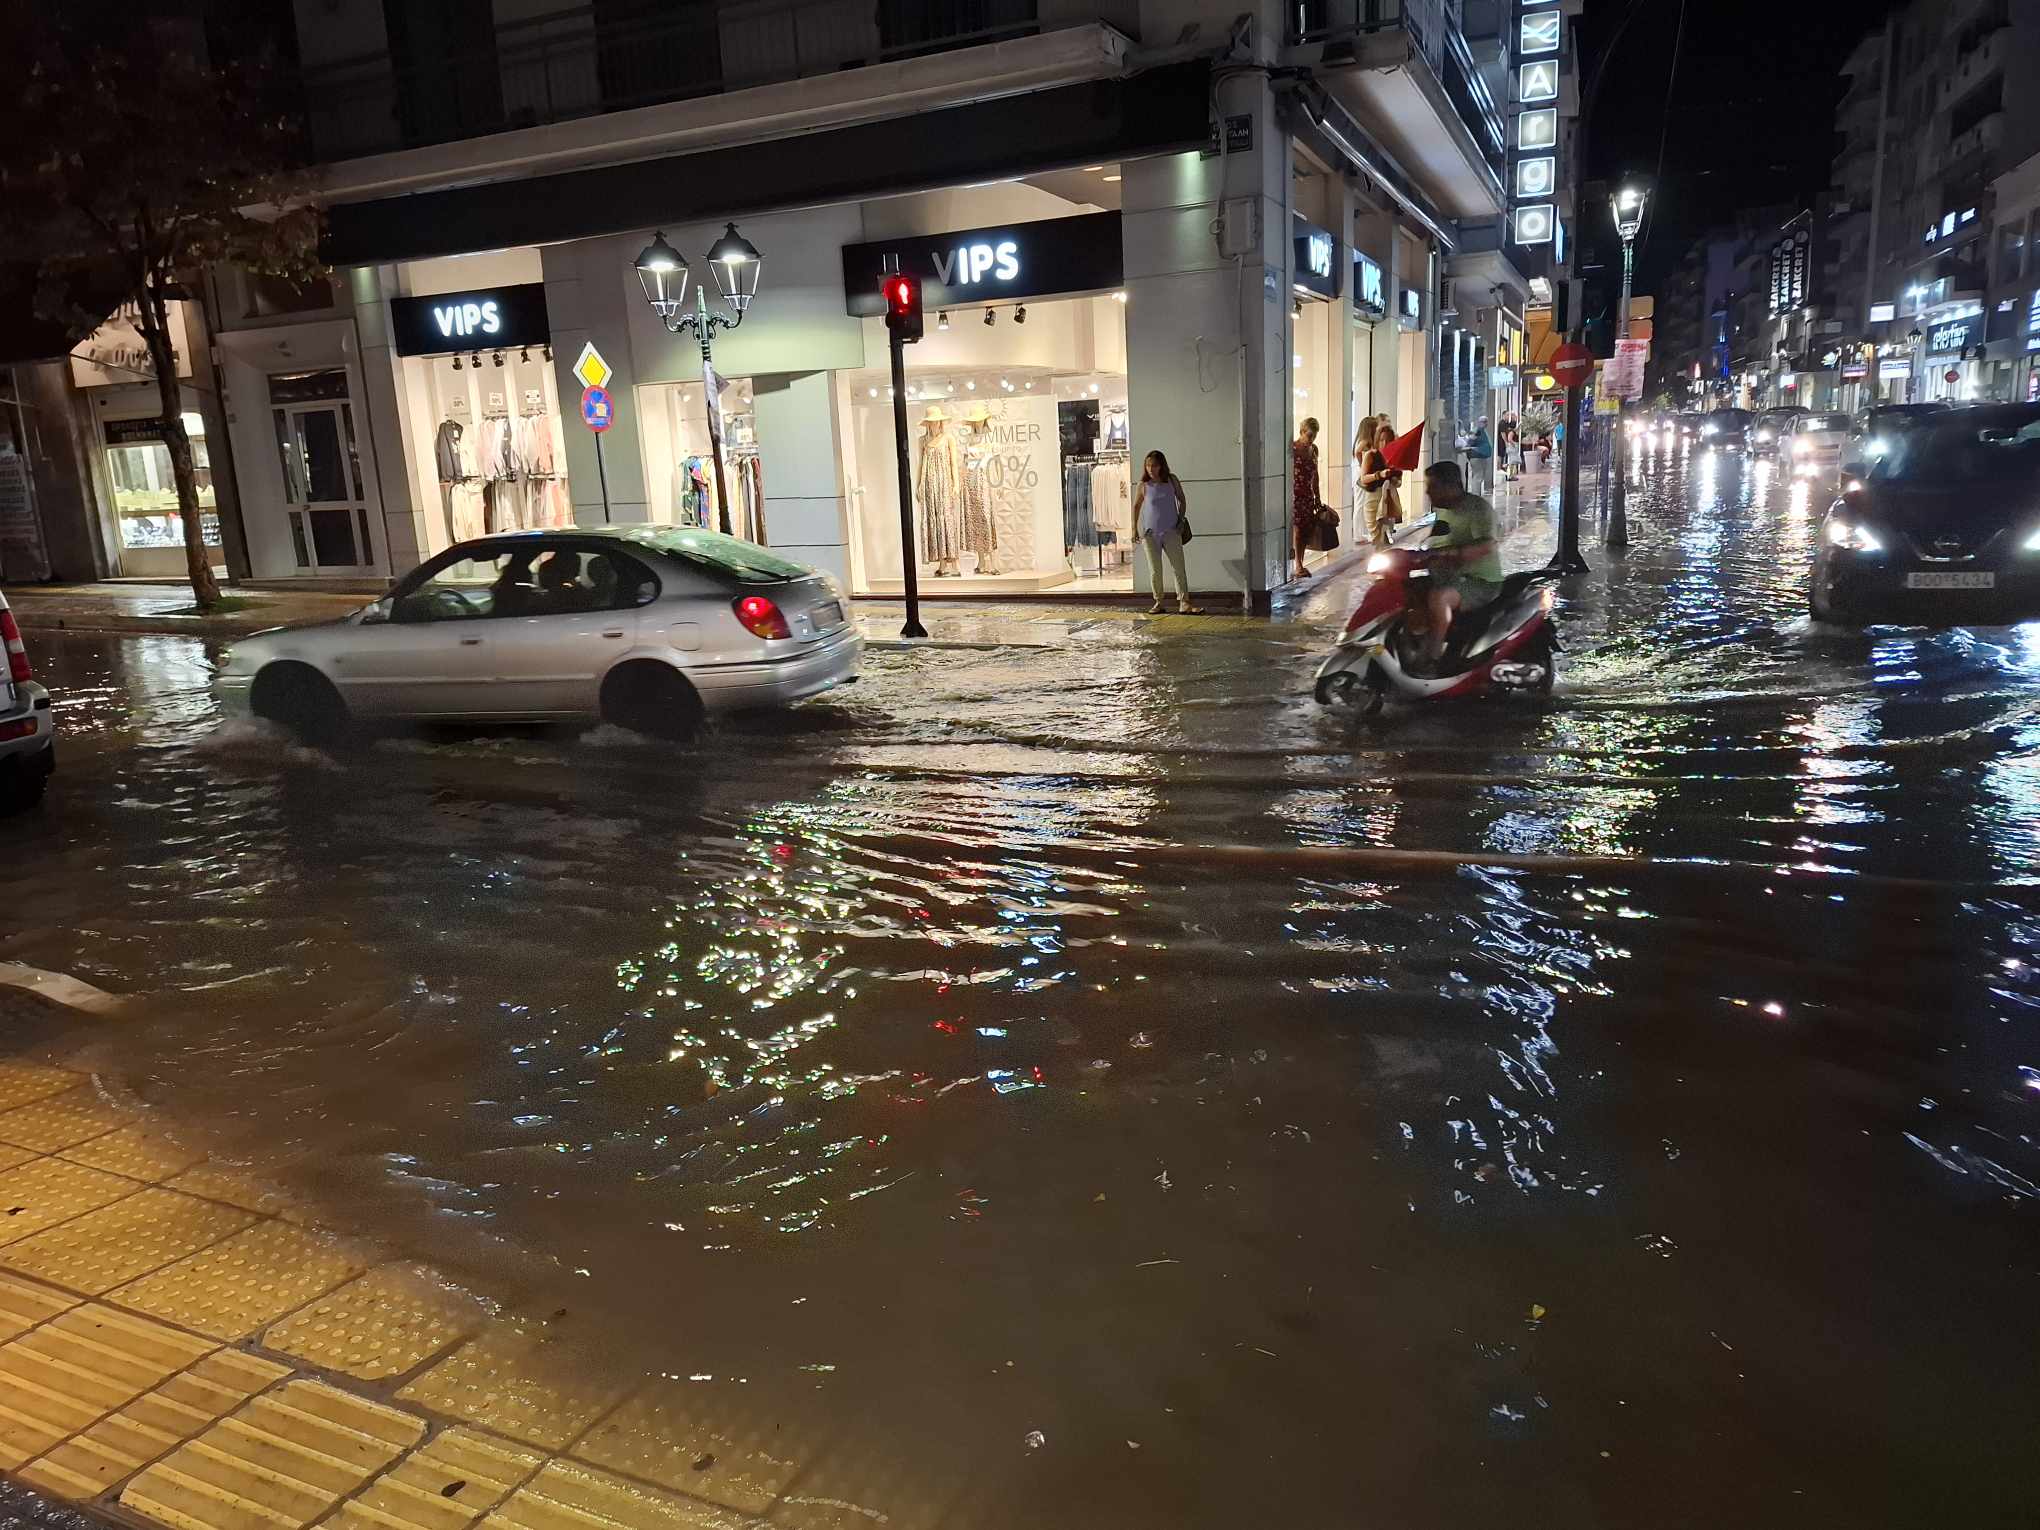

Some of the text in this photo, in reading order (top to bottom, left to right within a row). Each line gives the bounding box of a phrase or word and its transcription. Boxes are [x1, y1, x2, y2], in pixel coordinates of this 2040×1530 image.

[1521, 65, 1553, 237] Argo
[932, 241, 1020, 286] VIPS
[433, 301, 501, 337] VIPS
[958, 423, 1041, 445] SMMER
